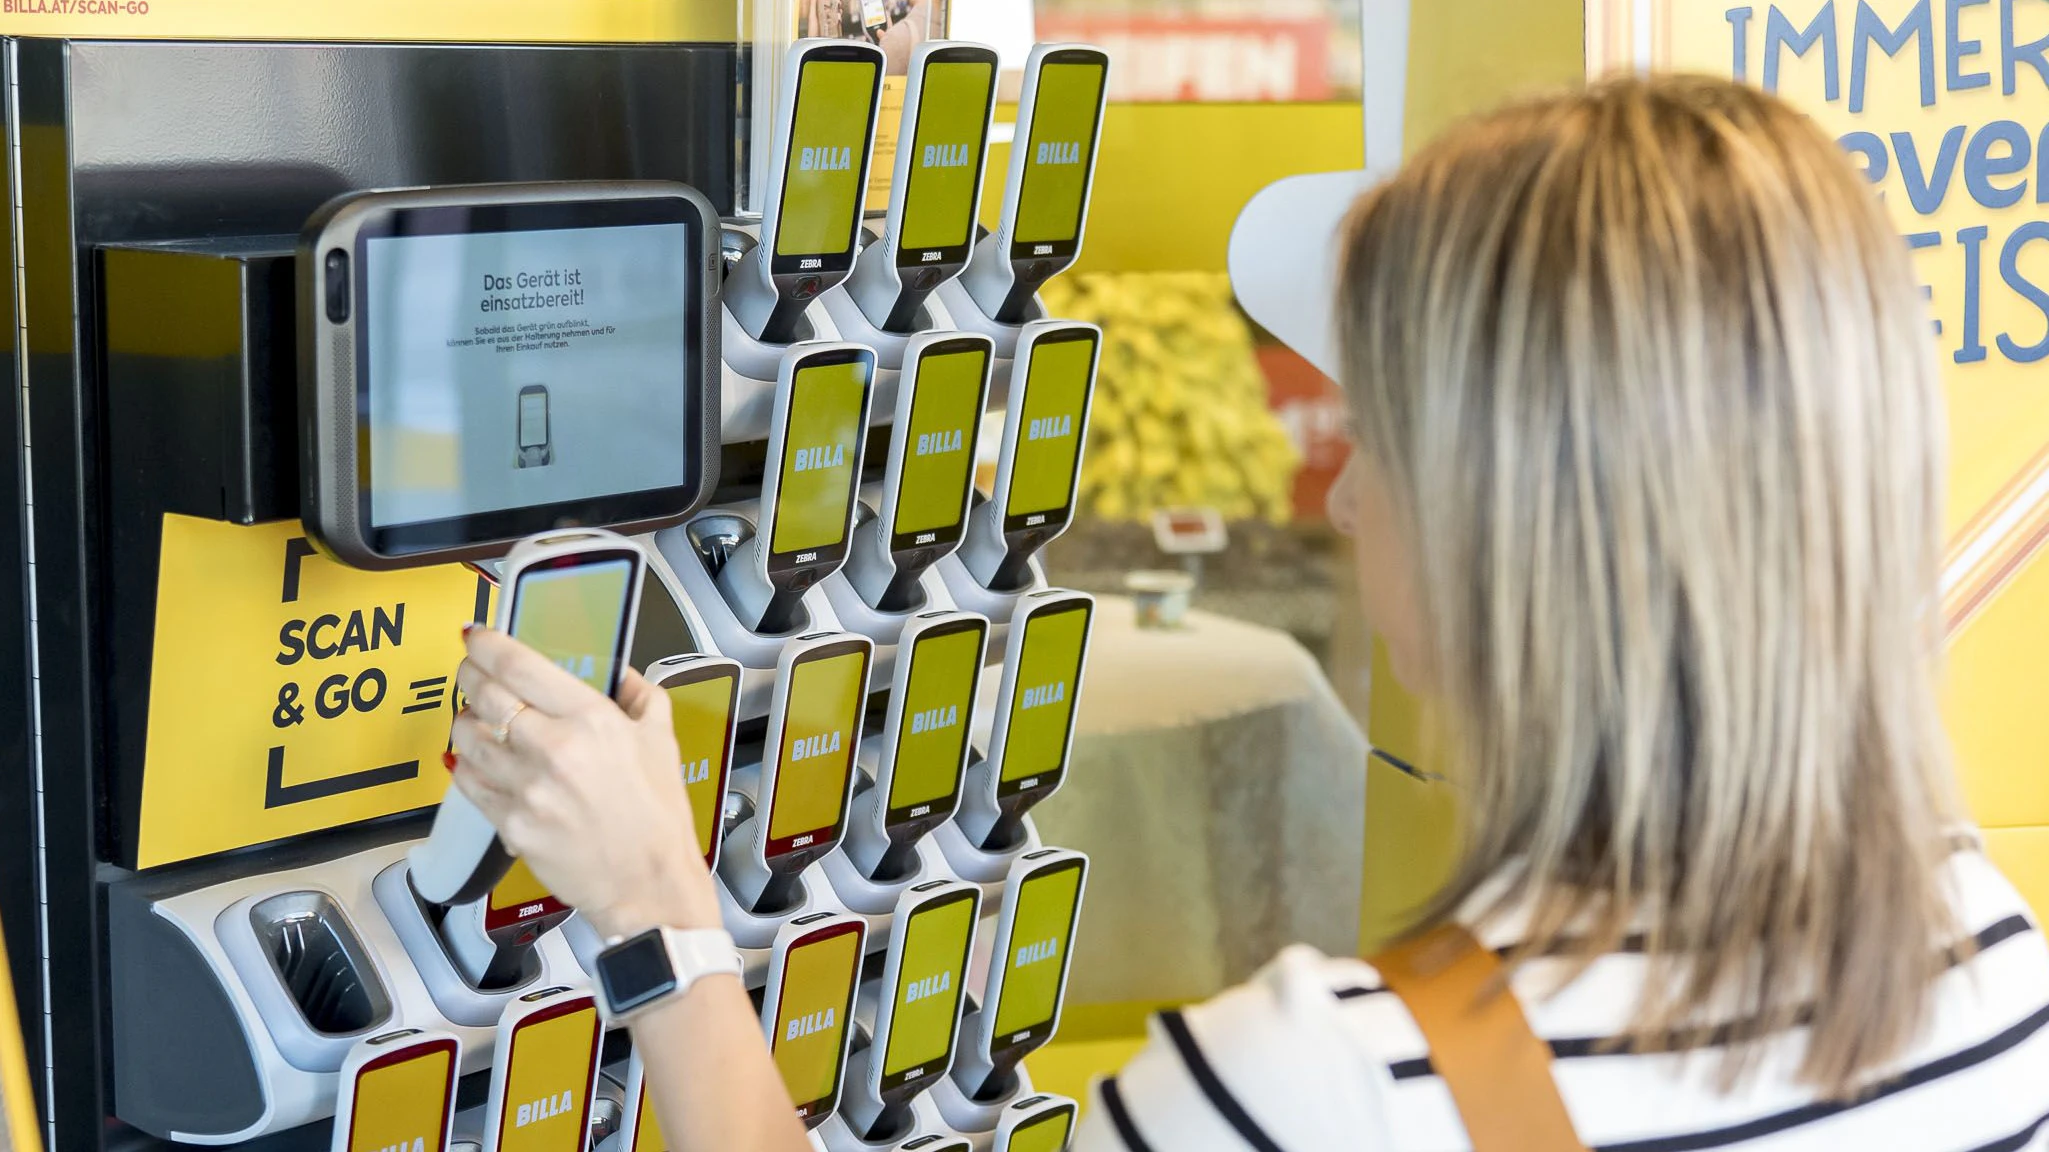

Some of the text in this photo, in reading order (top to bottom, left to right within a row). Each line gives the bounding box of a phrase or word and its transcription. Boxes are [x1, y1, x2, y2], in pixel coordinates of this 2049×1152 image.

[3, 0, 149, 14] BILLA.AT/SCAN-GO
[1725, 0, 2049, 113] IMMER
[798, 146, 851, 173] BILLA
[922, 143, 969, 168] BILLA
[1036, 141, 1079, 165] BILLA
[921, 251, 942, 262] ZEBRA
[1033, 245, 1053, 255] ZEBRA
[799, 258, 822, 269] ZEBRA
[484, 268, 581, 291] Das Gerät ist
[481, 289, 585, 312] einsatzbereit!
[475, 336, 486, 346] Sie
[487, 337, 495, 345] es
[496, 335, 509, 344] aus
[511, 334, 524, 342] der
[525, 331, 561, 341] Halterung
[561, 329, 590, 338] nehmen
[591, 327, 605, 336] und
[606, 325, 617, 335] für
[501, 325, 515, 334] das
[517, 323, 537, 332] Gerät
[539, 321, 556, 332] grün
[495, 340, 570, 354] Ihren Einkauf nutzen.
[1028, 415, 1071, 441] BILLA
[916, 429, 962, 456] BILLA
[794, 444, 844, 472] BILLA
[1026, 514, 1045, 526] ZEBRA
[915, 532, 936, 545] ZEBRA
[795, 551, 817, 564] ZEBRA
[275, 602, 405, 666] SCAN
[272, 667, 387, 728] & GO
[1022, 681, 1065, 710] BILLA
[911, 705, 957, 735] BILLA
[791, 730, 841, 762] BILLA
[1019, 778, 1038, 790] ZEBRA
[910, 805, 930, 818] ZEBRA
[791, 834, 814, 848] ZEBRA
[518, 902, 544, 918] ZEBRA
[1015, 937, 1058, 968] BILLA
[905, 970, 951, 1004] BILLA
[786, 1007, 835, 1042] BILLA
[1012, 1030, 1031, 1043] ZEBRA
[904, 1067, 924, 1081] ZEBRA
[515, 1089, 574, 1129] BILLA
